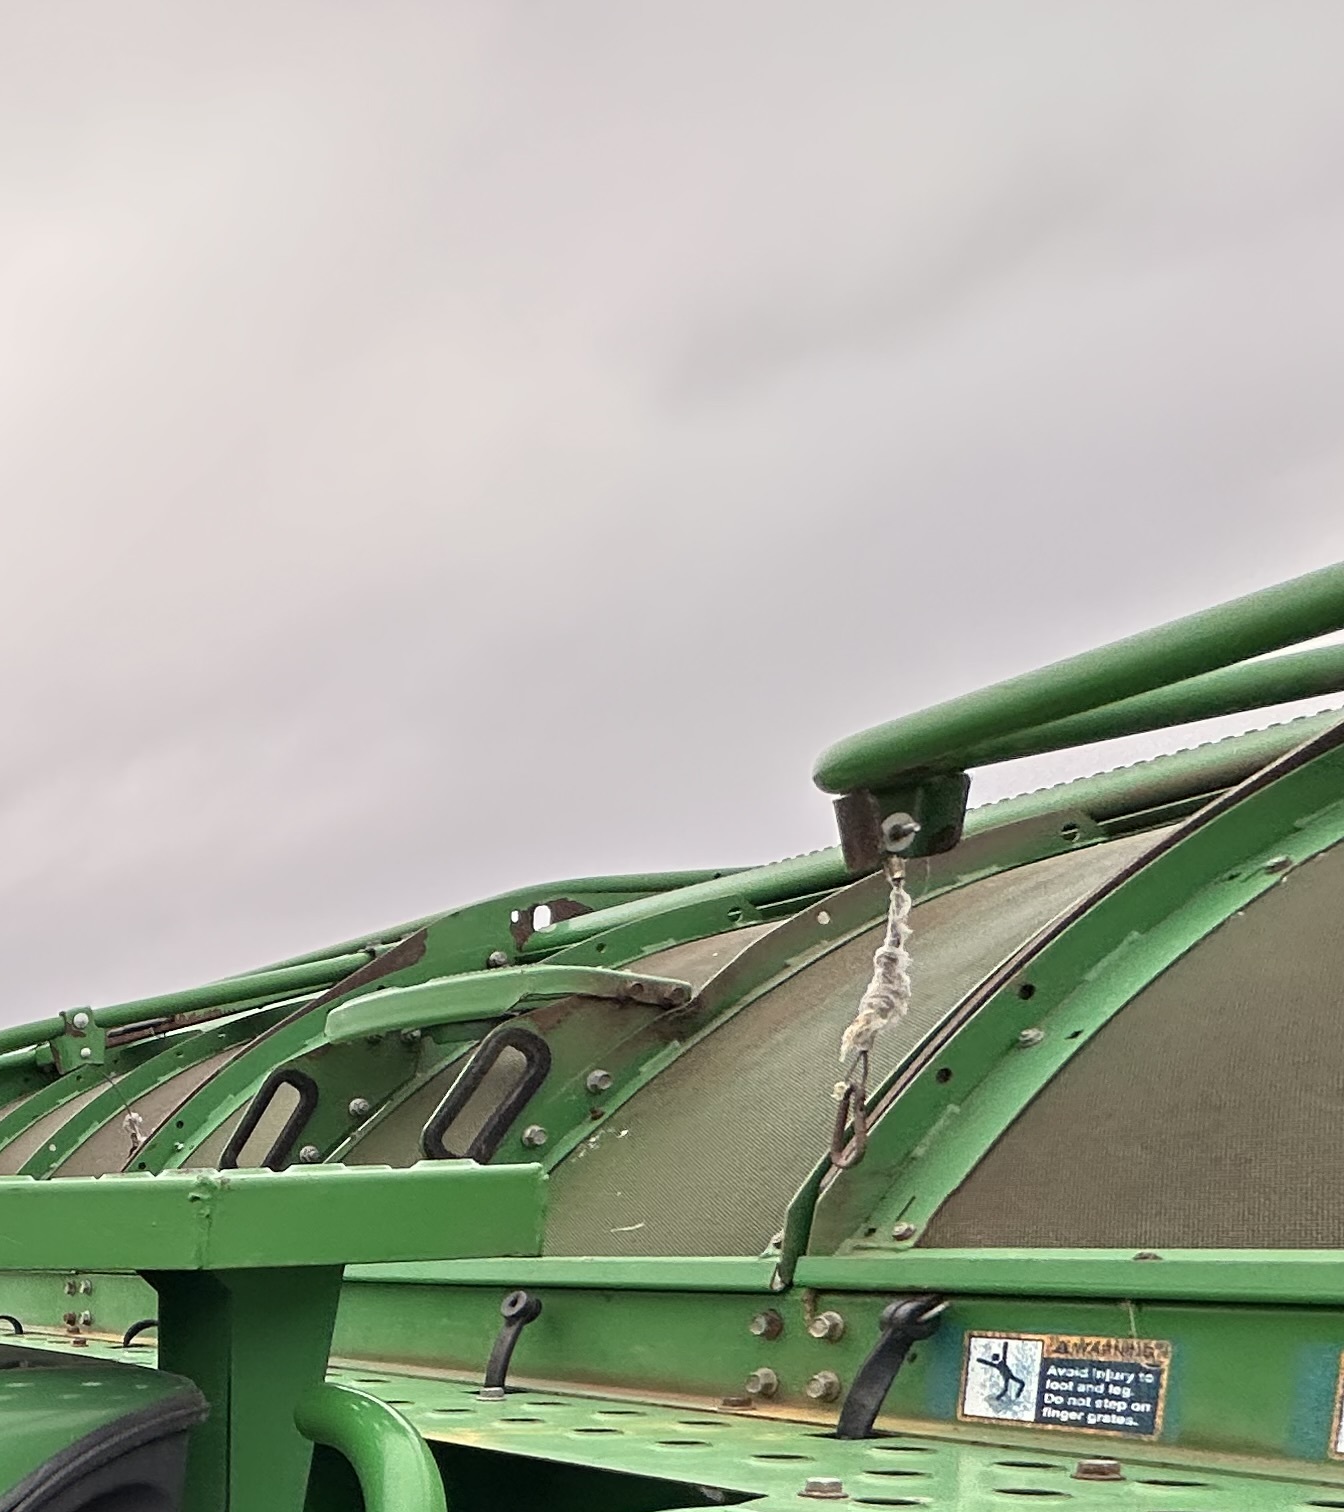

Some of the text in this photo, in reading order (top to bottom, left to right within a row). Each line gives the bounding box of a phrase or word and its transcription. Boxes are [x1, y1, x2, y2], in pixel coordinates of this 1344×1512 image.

[1047, 1365, 1089, 1378] Avoid
[1138, 1372, 1154, 1383] to
[1077, 1383, 1105, 1394] and
[1043, 1393, 1152, 1412] Do not step on
[1042, 1406, 1084, 1422] finger
